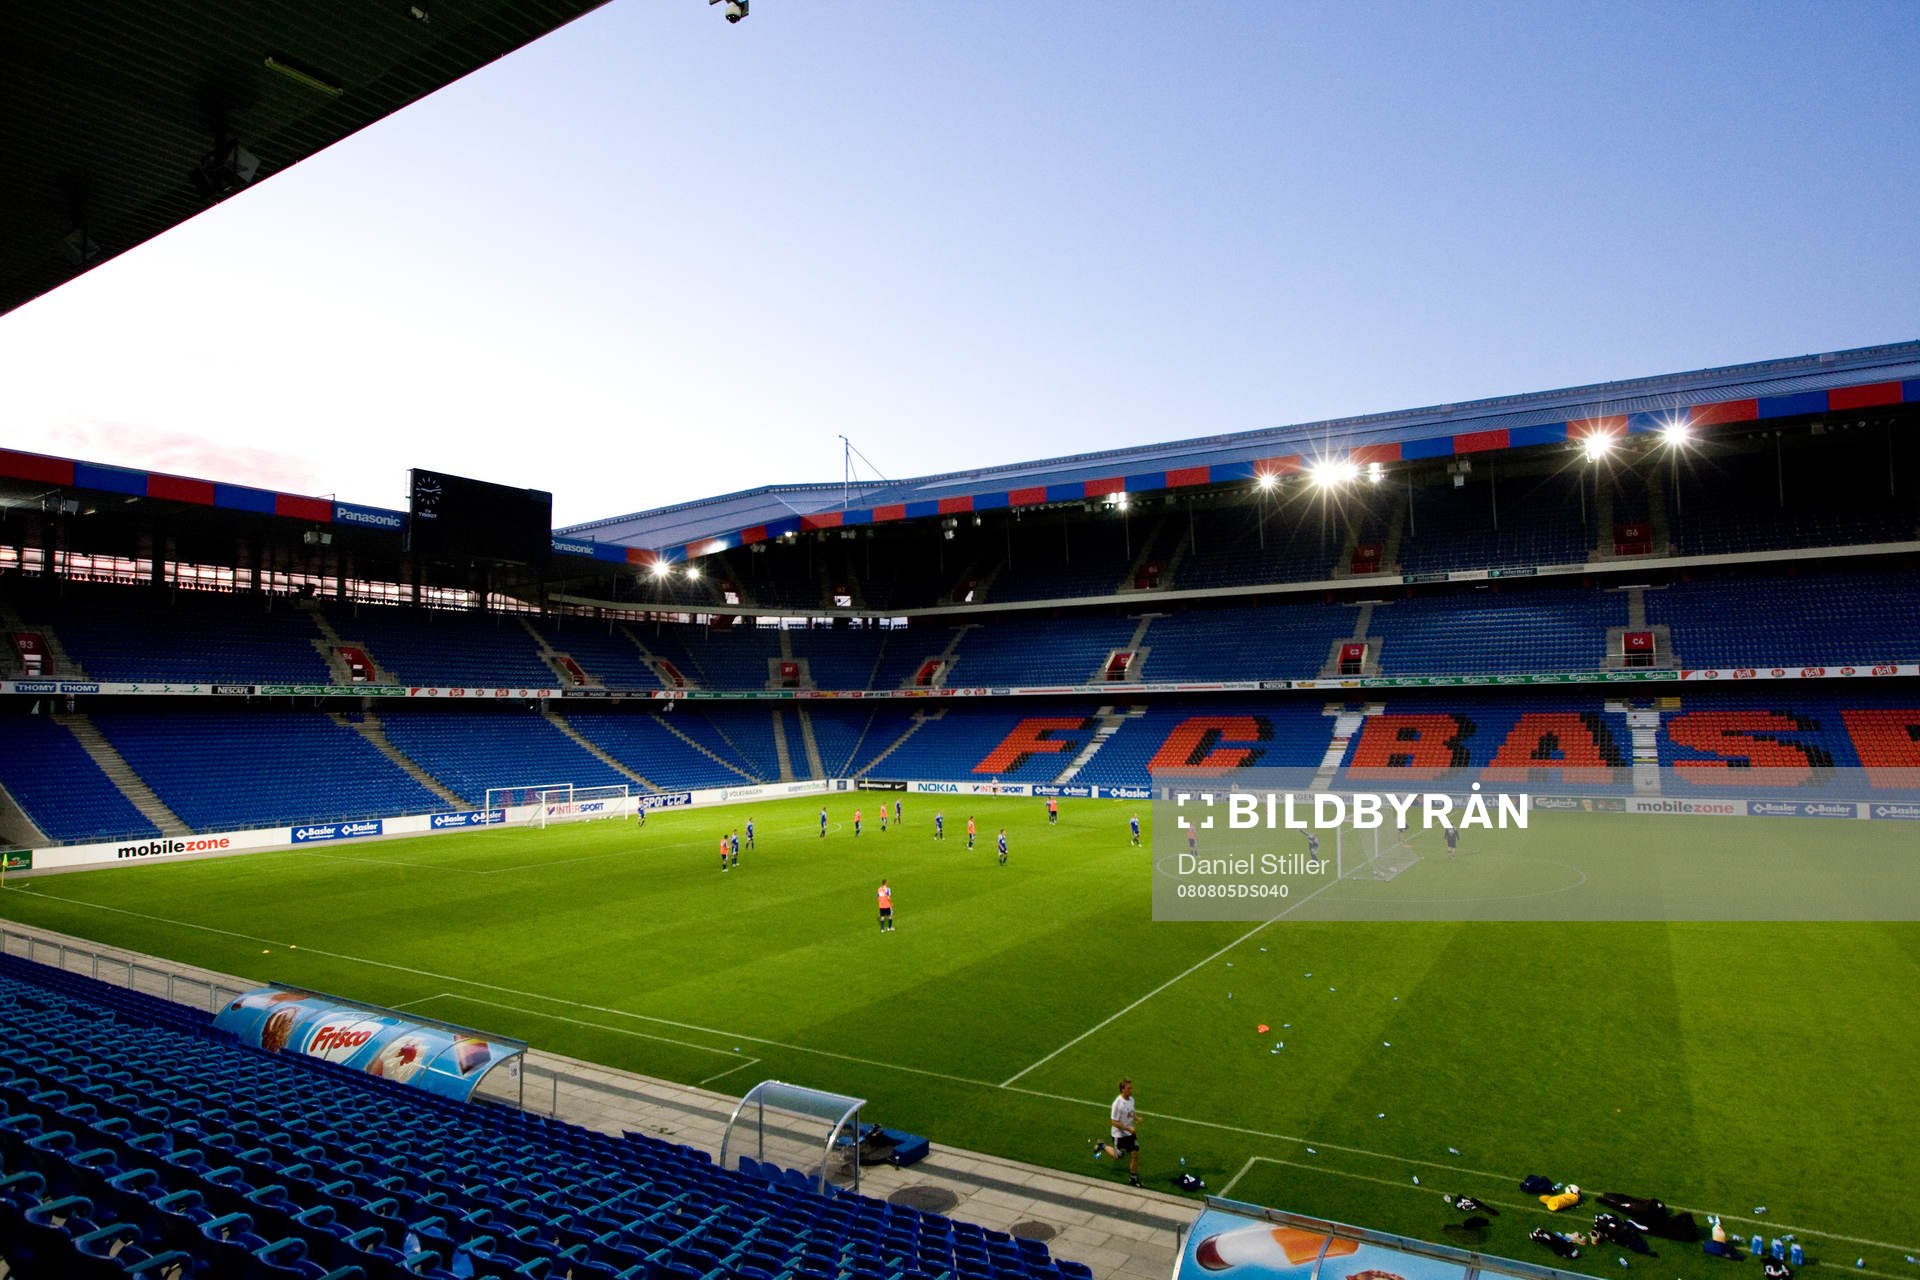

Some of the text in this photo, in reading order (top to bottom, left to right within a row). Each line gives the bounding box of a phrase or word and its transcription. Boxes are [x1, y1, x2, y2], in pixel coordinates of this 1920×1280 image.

[337, 507, 401, 527] Panasonic
[551, 540, 594, 555] Panasonic
[1805, 668, 1820, 677] Bell
[1876, 665, 1893, 676] Bell
[18, 684, 55, 692] THOMY
[917, 783, 959, 793] NOKIA
[980, 784, 1024, 793] INTRSPORT
[1120, 788, 1150, 798] Basler
[1535, 798, 1578, 808] Carlsberg
[1637, 801, 1734, 813] mobilezone
[1766, 803, 1851, 813] Basler Basler
[1890, 805, 1920, 814] Basle
[444, 811, 502, 823] Basler Bsler
[308, 822, 378, 836] Basler Basler
[118, 838, 230, 859] mobilezone
[310, 1027, 373, 1052] Frisco
